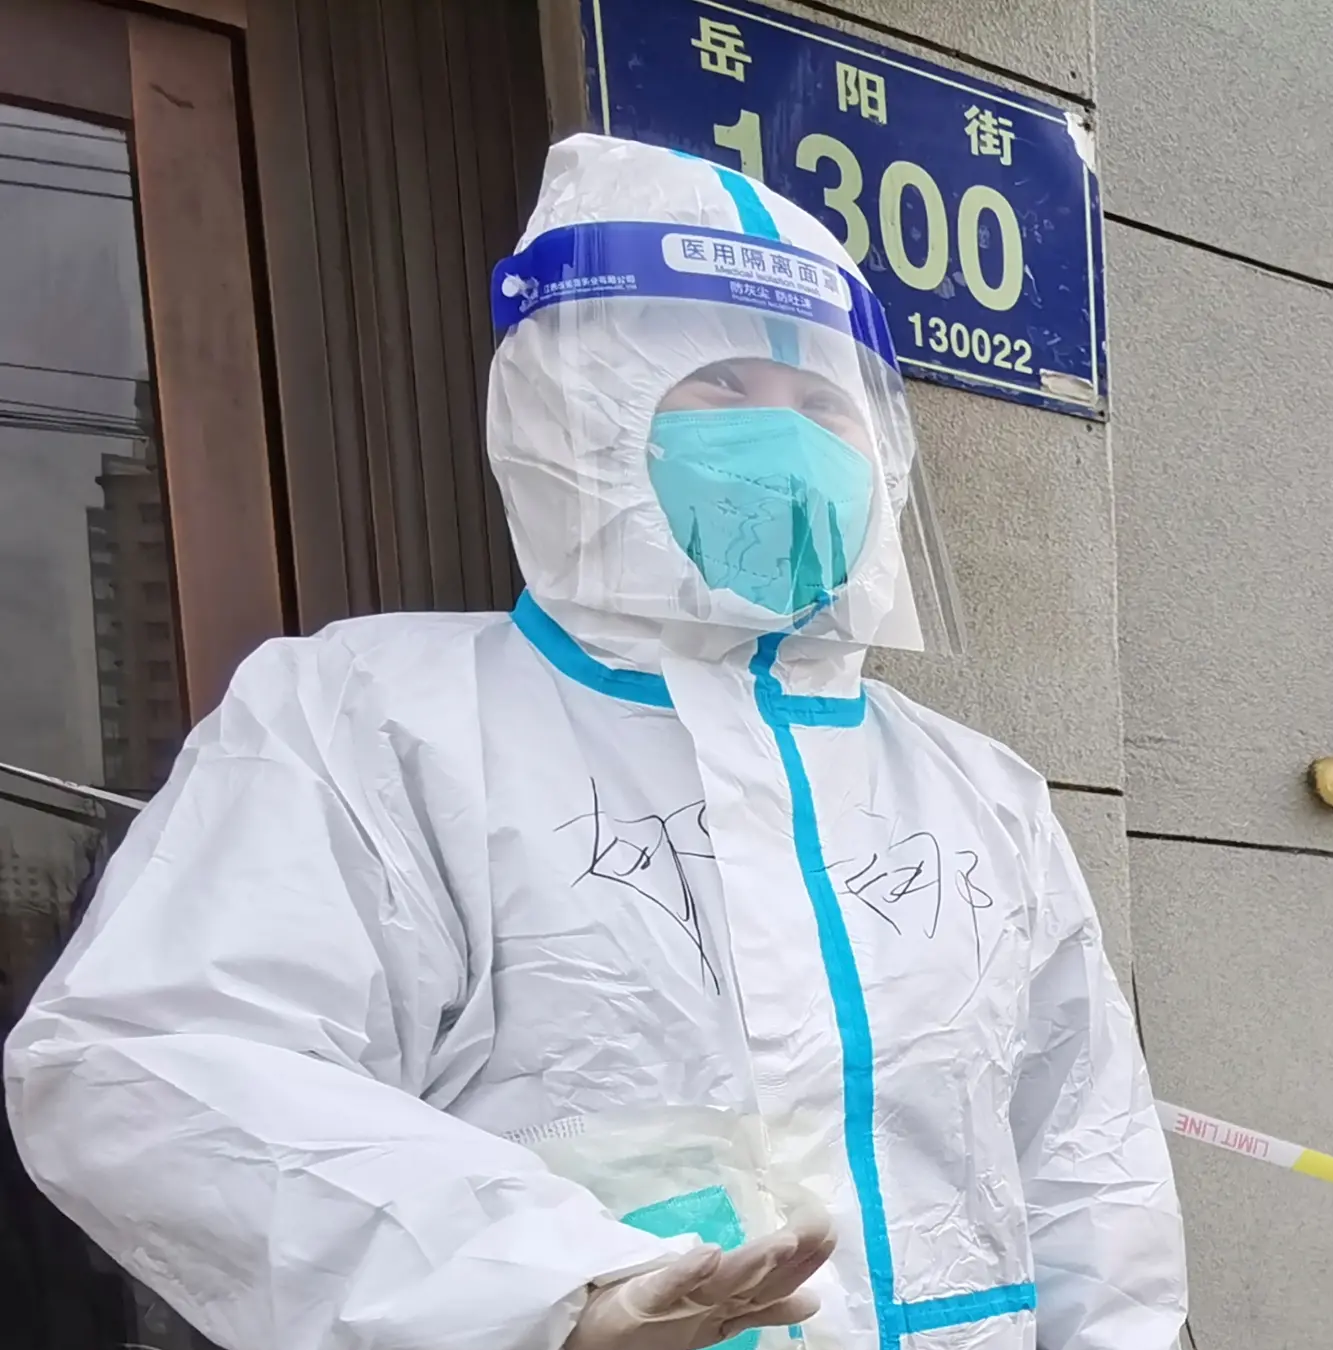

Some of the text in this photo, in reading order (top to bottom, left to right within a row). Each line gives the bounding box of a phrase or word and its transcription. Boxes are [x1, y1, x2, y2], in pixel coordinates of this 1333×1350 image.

[690, 16, 1015, 167] 岳阳街
[713, 109, 1024, 311] 1300
[681, 238, 840, 296] 医用隔离面罩
[907, 312, 1033, 375] 130022
[1174, 1112, 1270, 1158] LIMIT LINE
